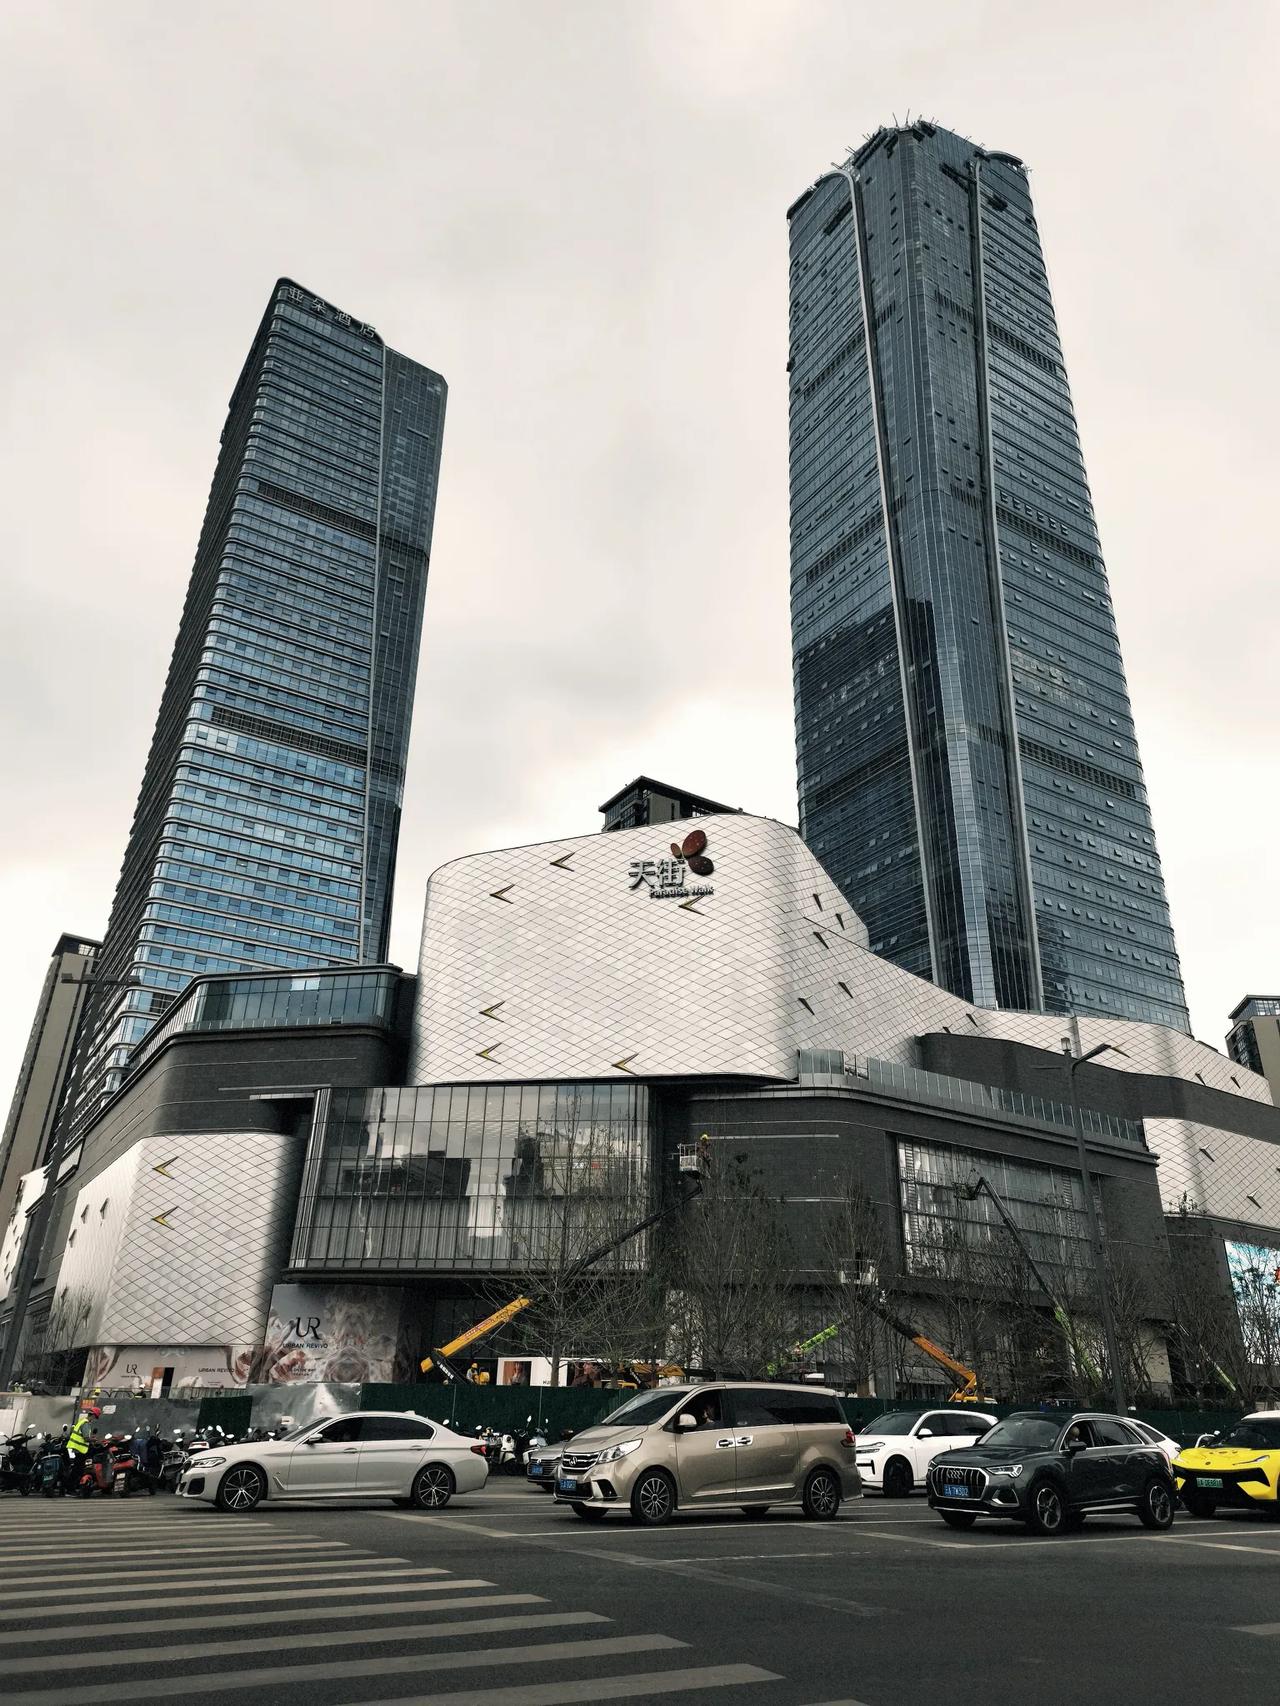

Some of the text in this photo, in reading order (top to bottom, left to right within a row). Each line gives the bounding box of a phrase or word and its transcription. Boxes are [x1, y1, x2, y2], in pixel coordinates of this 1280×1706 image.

[288, 287, 376, 338] 亚朵酒店
[628, 858, 686, 890] 天街
[296, 1316, 322, 1340] UR
